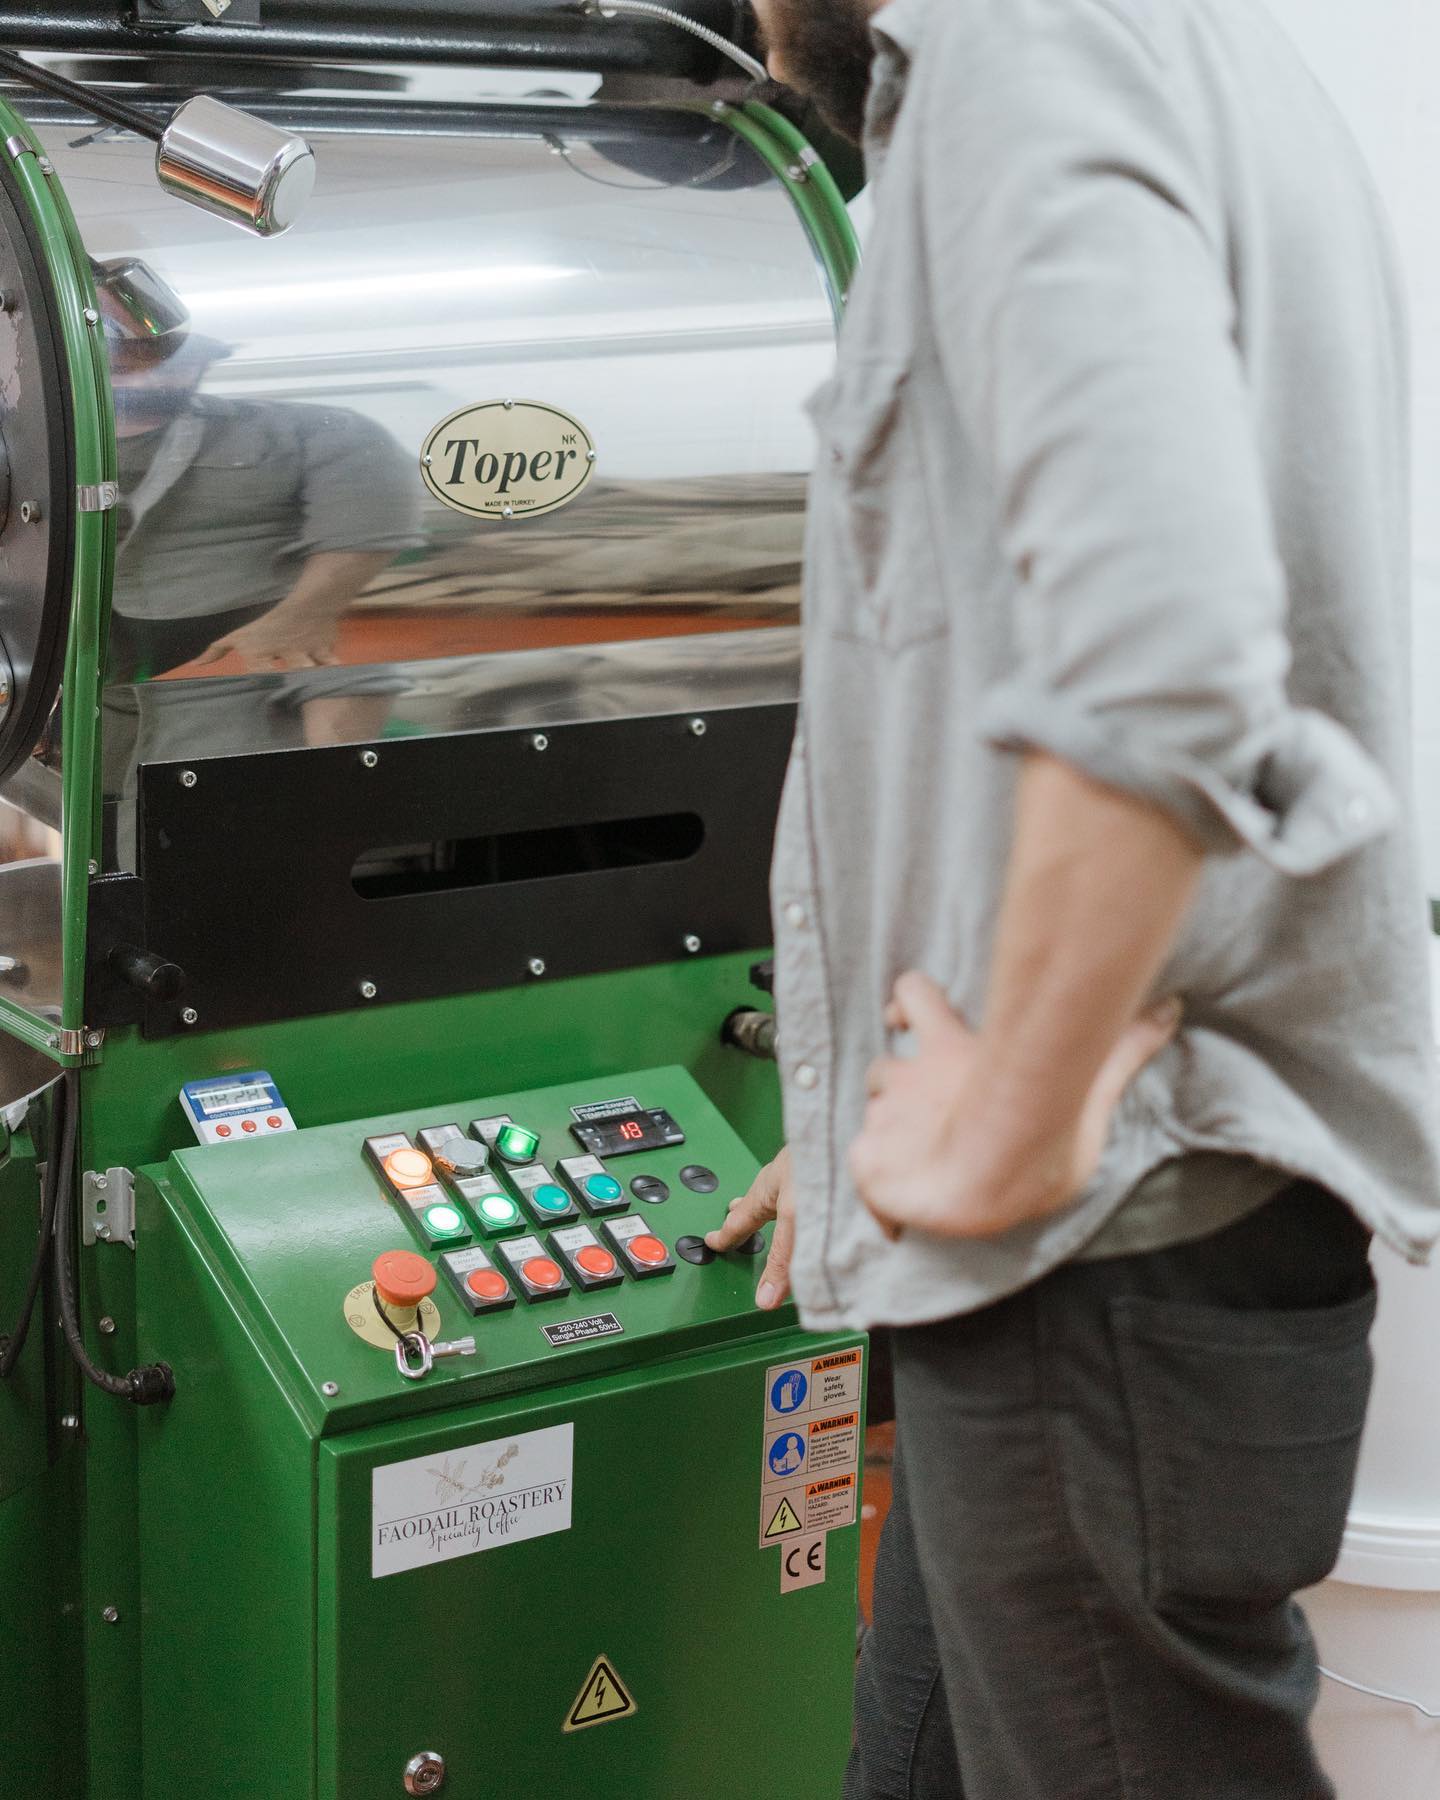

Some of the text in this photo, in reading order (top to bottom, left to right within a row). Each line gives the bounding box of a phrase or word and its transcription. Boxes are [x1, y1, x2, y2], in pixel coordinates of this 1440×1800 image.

[562, 435, 577, 445] NK
[444, 439, 577, 494] Toper
[582, 1105, 638, 1120] TEMPERATURE
[620, 1121, 643, 1140] 18
[552, 1322, 618, 1341] Single Phase 50Hz
[558, 1318, 604, 1333] 220-240 Volt
[822, 1352, 856, 1368] WARNING
[824, 1375, 841, 1383] Wear
[824, 1383, 844, 1392] safety
[820, 1415, 854, 1430] WARNING
[817, 1477, 851, 1492] WARNING
[832, 1490, 848, 1498] SHOCK
[378, 1484, 567, 1546] FAODAIL ROASTERY
[488, 1512, 520, 1535] Coffee
[786, 1542, 822, 1578] CE
